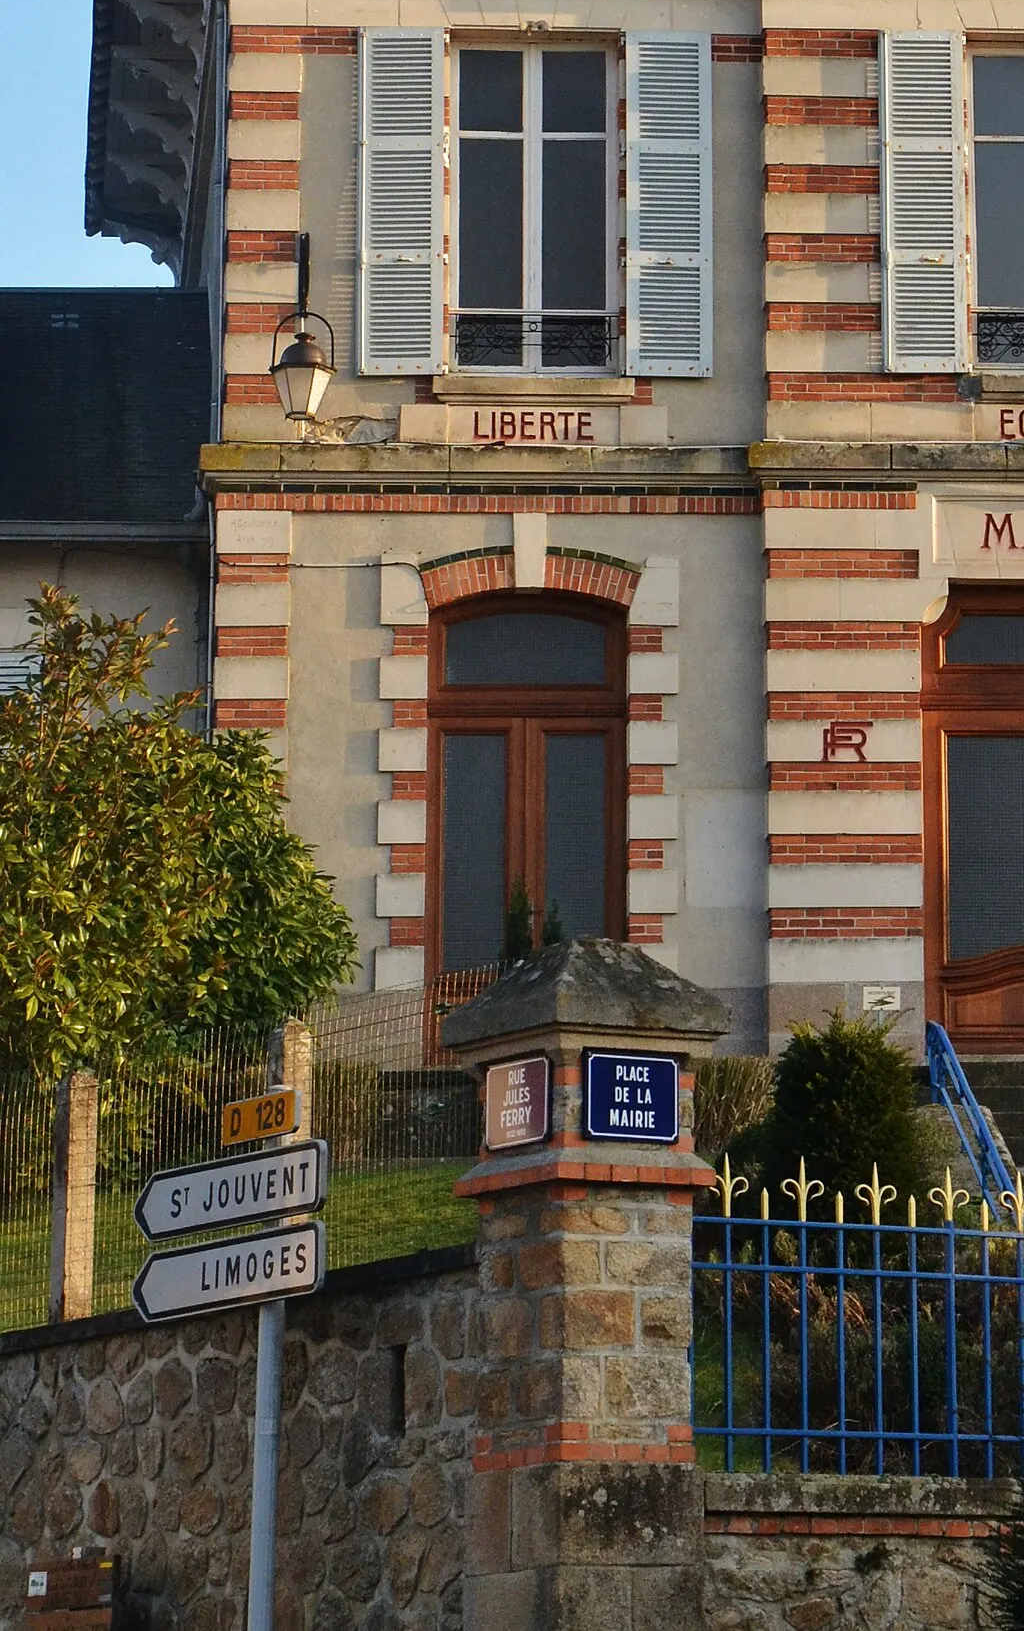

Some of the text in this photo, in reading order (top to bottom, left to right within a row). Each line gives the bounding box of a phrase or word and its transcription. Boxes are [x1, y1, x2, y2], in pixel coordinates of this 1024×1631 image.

[473, 411, 595, 441] LIBERTE
[508, 1068, 526, 1086] RUE
[615, 1064, 650, 1083] PLACE
[502, 1086, 531, 1107] JULES
[614, 1086, 653, 1104] DE LA
[230, 1097, 286, 1138] D 128
[500, 1105, 532, 1128] FERRY
[609, 1108, 656, 1129] MAIRIE
[203, 1162, 309, 1212] JOUVENT
[201, 1243, 307, 1291] LIMOGES
